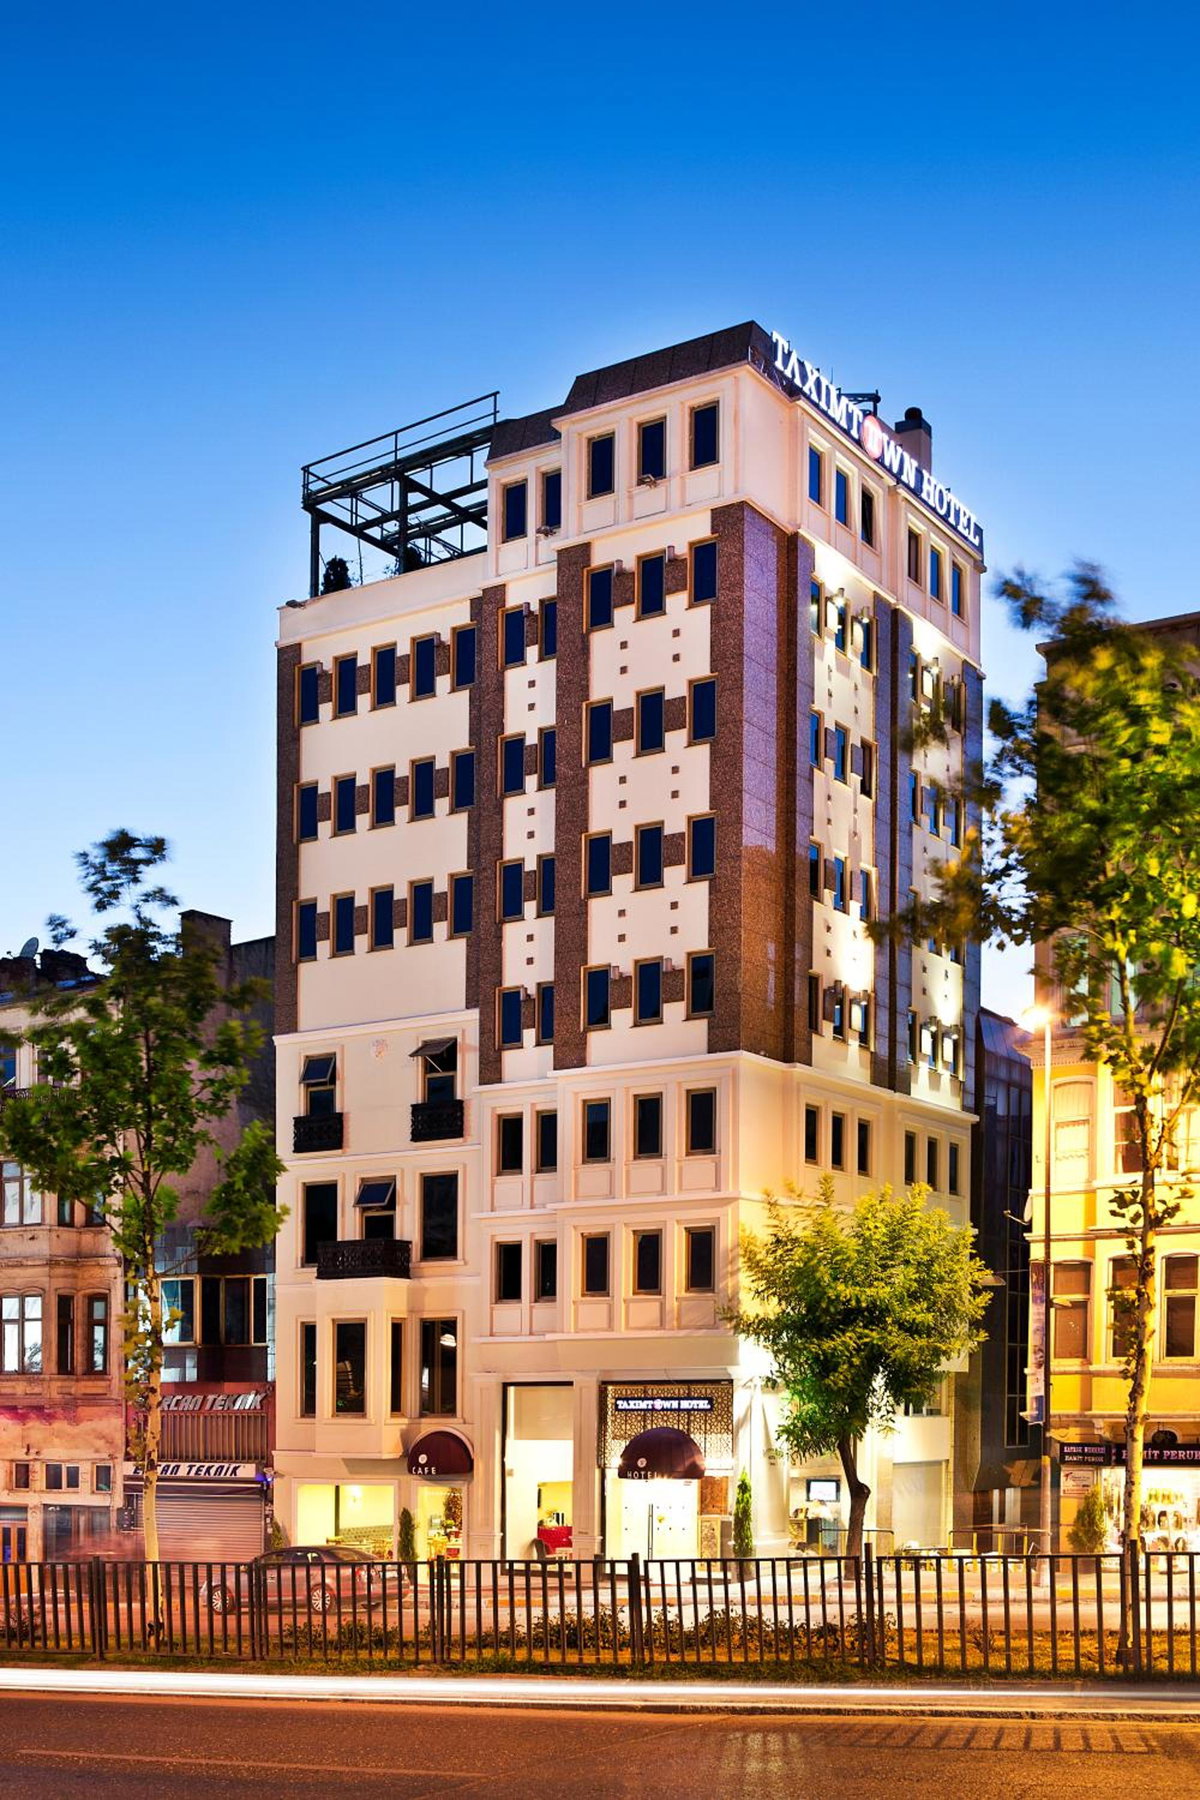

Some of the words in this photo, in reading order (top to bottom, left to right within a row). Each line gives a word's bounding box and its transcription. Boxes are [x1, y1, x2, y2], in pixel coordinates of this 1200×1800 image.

[921, 469, 980, 546] HOTEL
[159, 1394, 204, 1411] RCAN
[680, 1400, 711, 1410] HOTEL
[412, 1466, 437, 1475] CAFE
